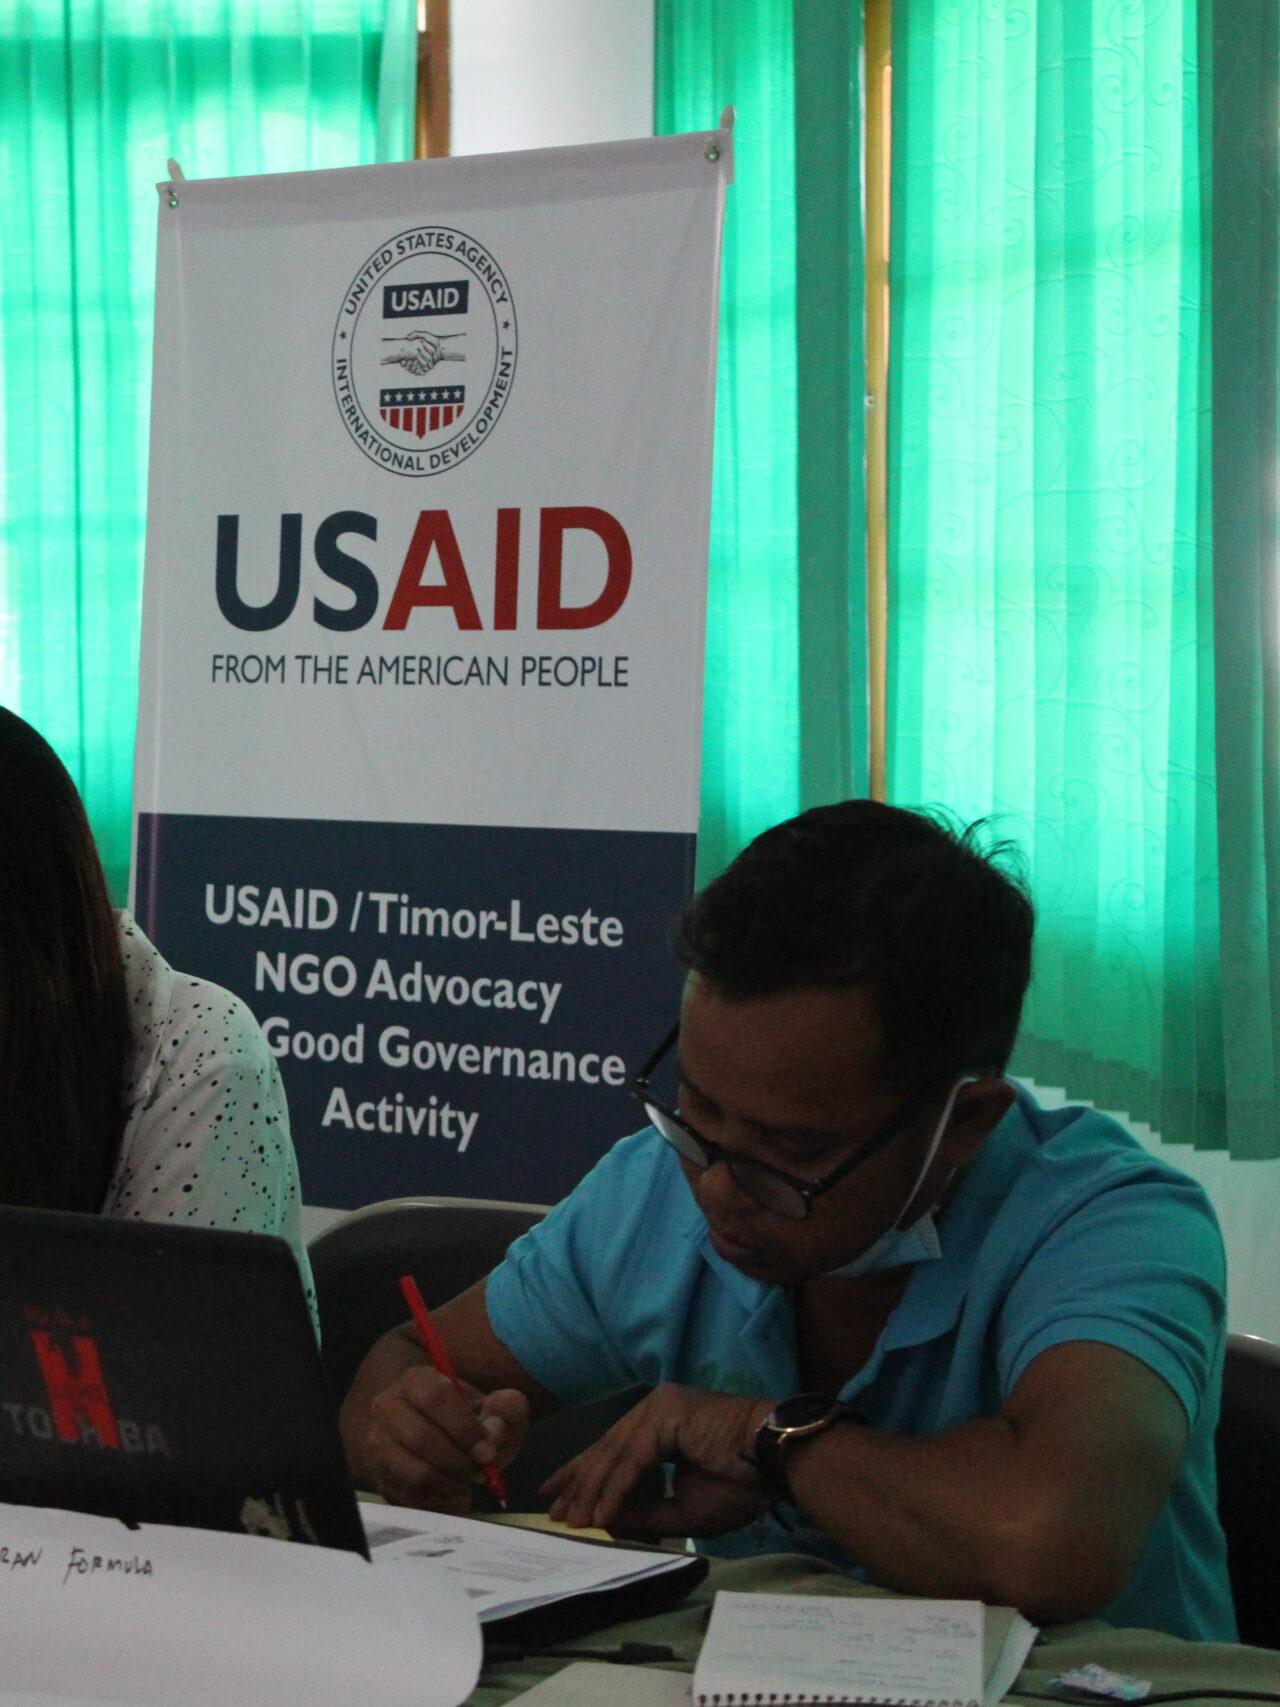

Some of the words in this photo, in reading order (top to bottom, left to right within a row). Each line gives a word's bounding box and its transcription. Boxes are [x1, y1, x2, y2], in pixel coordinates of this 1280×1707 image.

[345, 249, 393, 316] UNITED
[395, 232, 455, 255] STATES
[454, 240, 508, 305] AGENCY
[391, 287, 460, 312] USAID
[336, 358, 425, 471] INTERNATIONAL
[429, 346, 513, 470] DEVELOPMENT
[215, 506, 633, 632] USAID
[212, 654, 285, 684] FROM
[295, 655, 348, 685] THE
[357, 655, 508, 686] AMERICAN
[521, 656, 629, 687] PEOPLE
[204, 883, 338, 930] USAID
[369, 891, 624, 947] Timor-Leste
[254, 951, 357, 996] NGO
[365, 958, 562, 1024] Advocacy
[264, 1016, 365, 1064] Good
[378, 1025, 626, 1086] Governance
[321, 1087, 479, 1153] Activity
[63, 1546, 154, 1585] FORMULA
